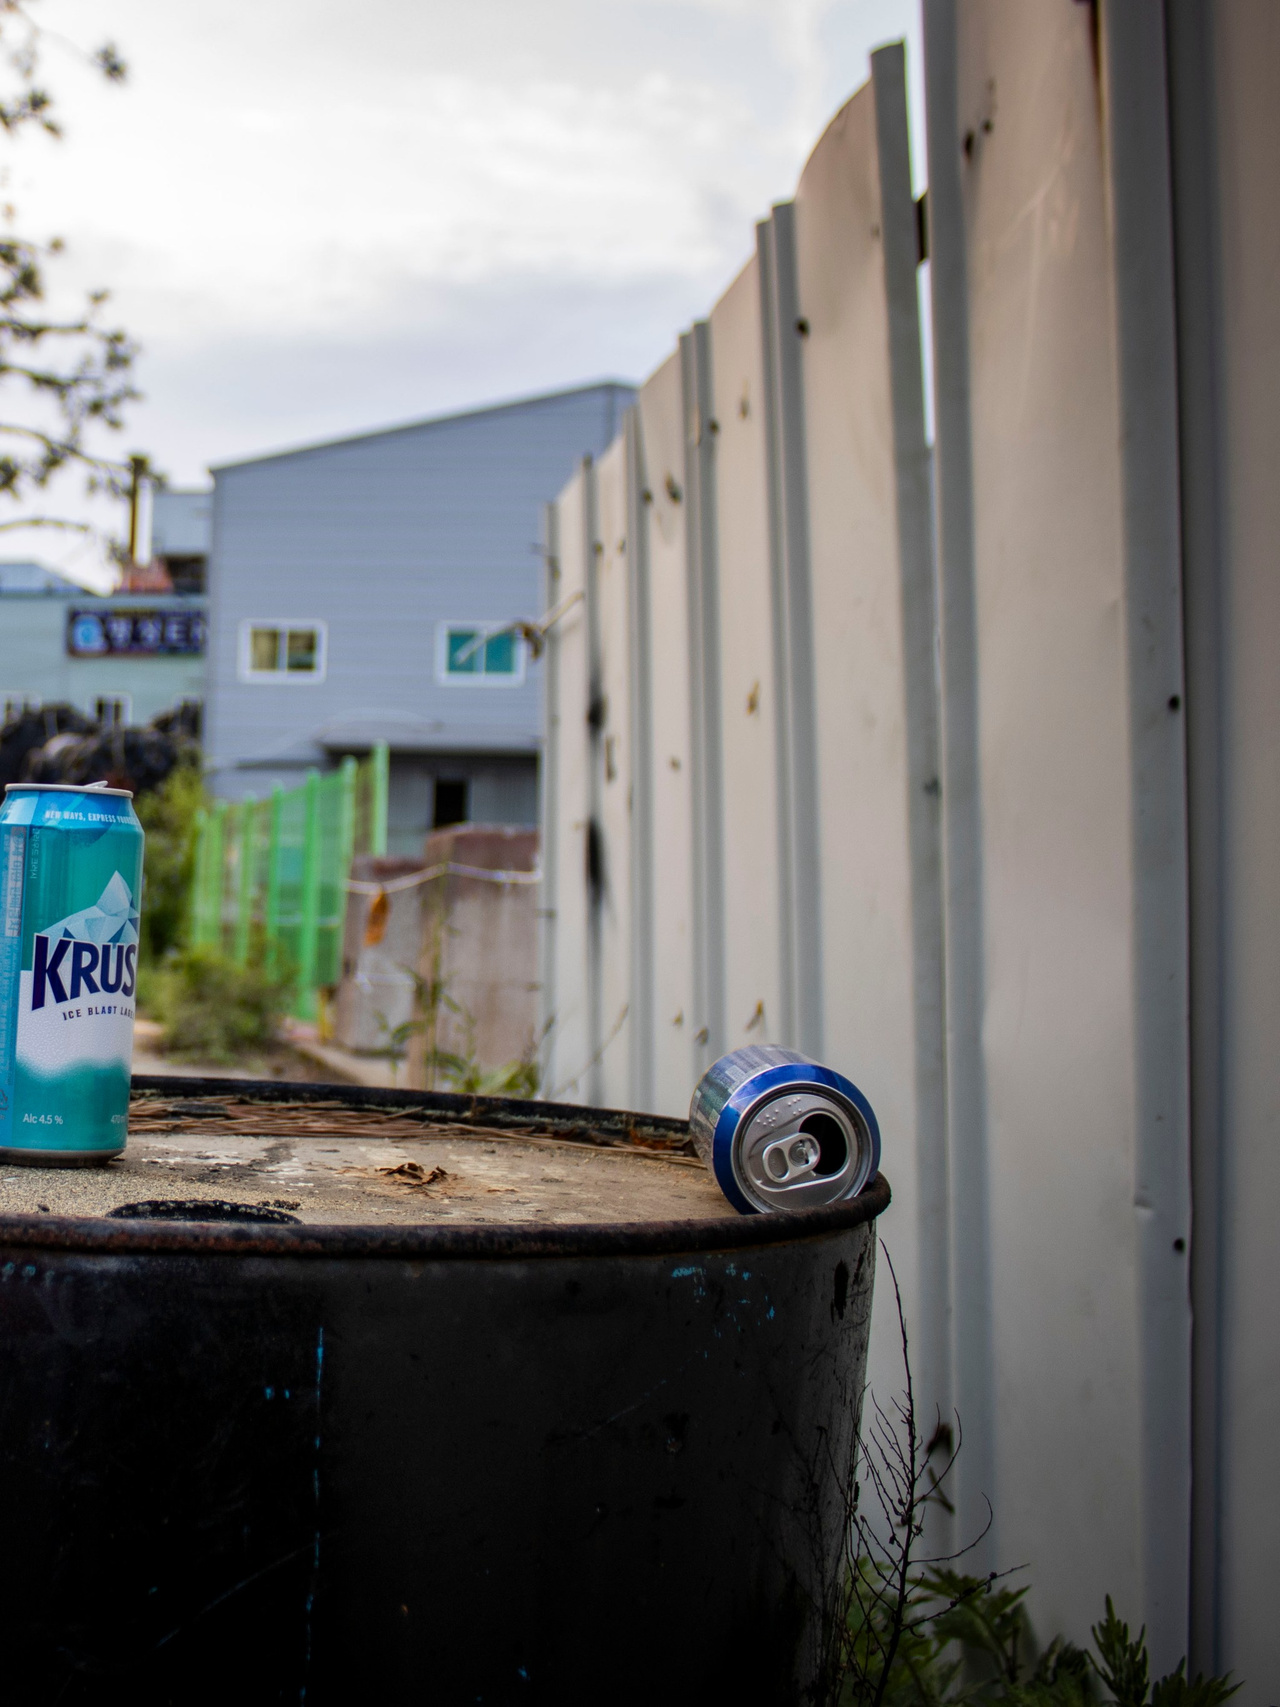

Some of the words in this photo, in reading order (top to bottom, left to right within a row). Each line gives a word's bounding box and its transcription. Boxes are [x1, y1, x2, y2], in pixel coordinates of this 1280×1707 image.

[44, 810, 61, 819] NEW
[63, 811, 86, 821] WAYS,
[88, 812, 116, 823] EXPRESS
[62, 1008, 82, 1021] ICE
[88, 1006, 117, 1016] BLAST
[22, 1113, 37, 1124] Alc
[39, 1114, 53, 1125] 4.5
[54, 1114, 63, 1125] %
